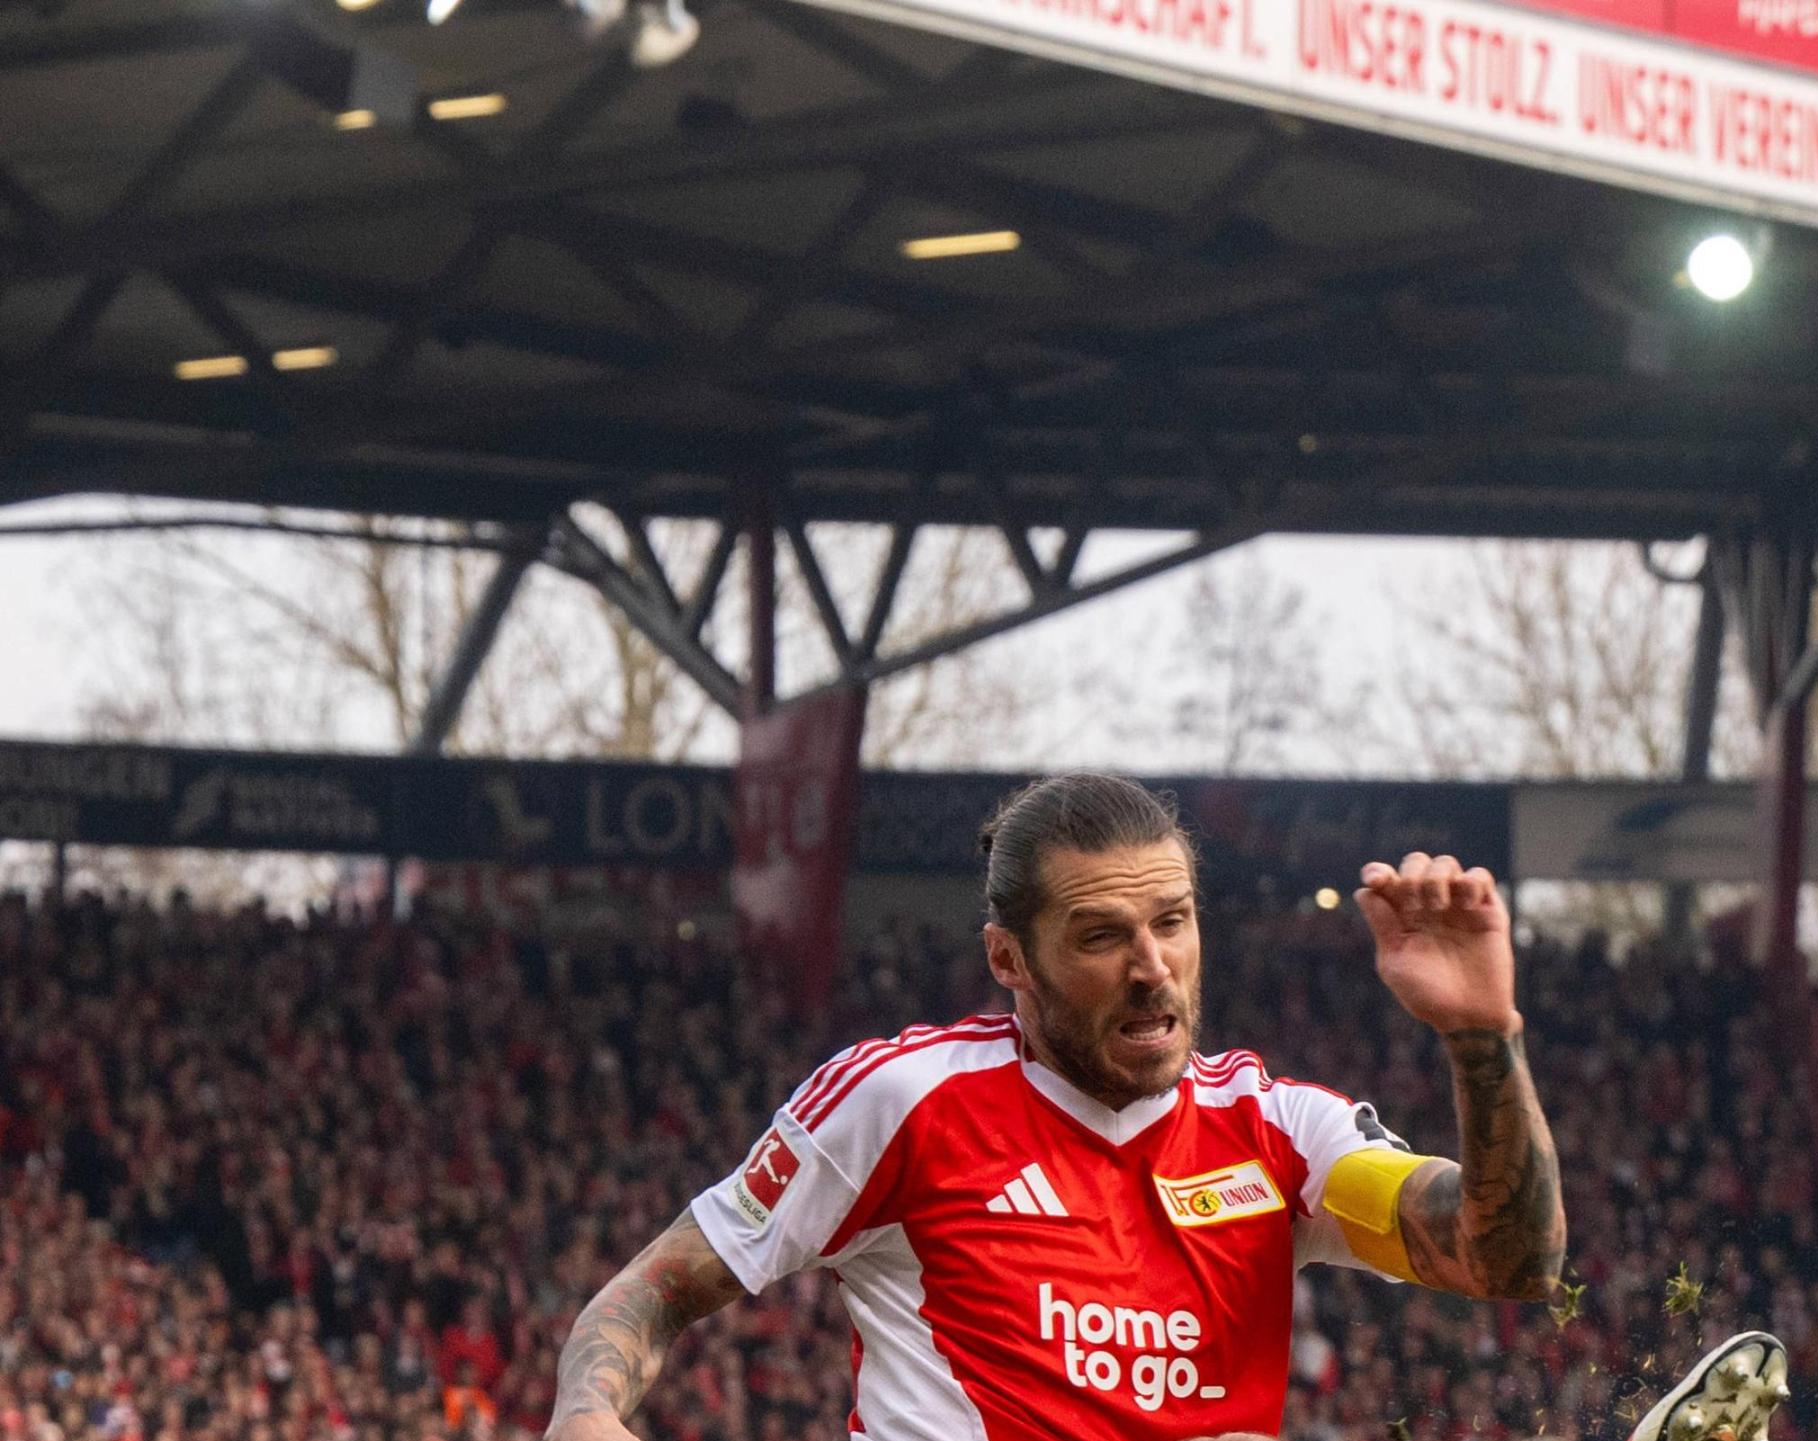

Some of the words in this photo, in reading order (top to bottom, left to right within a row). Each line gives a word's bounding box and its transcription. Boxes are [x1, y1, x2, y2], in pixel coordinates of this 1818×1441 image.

[1299, 0, 1428, 95] UNSER
[1576, 52, 1698, 156] UNSER
[1219, 1182, 1269, 1208] UNION
[1039, 1282, 1200, 1351] home
[1064, 1341, 1121, 1391] to
